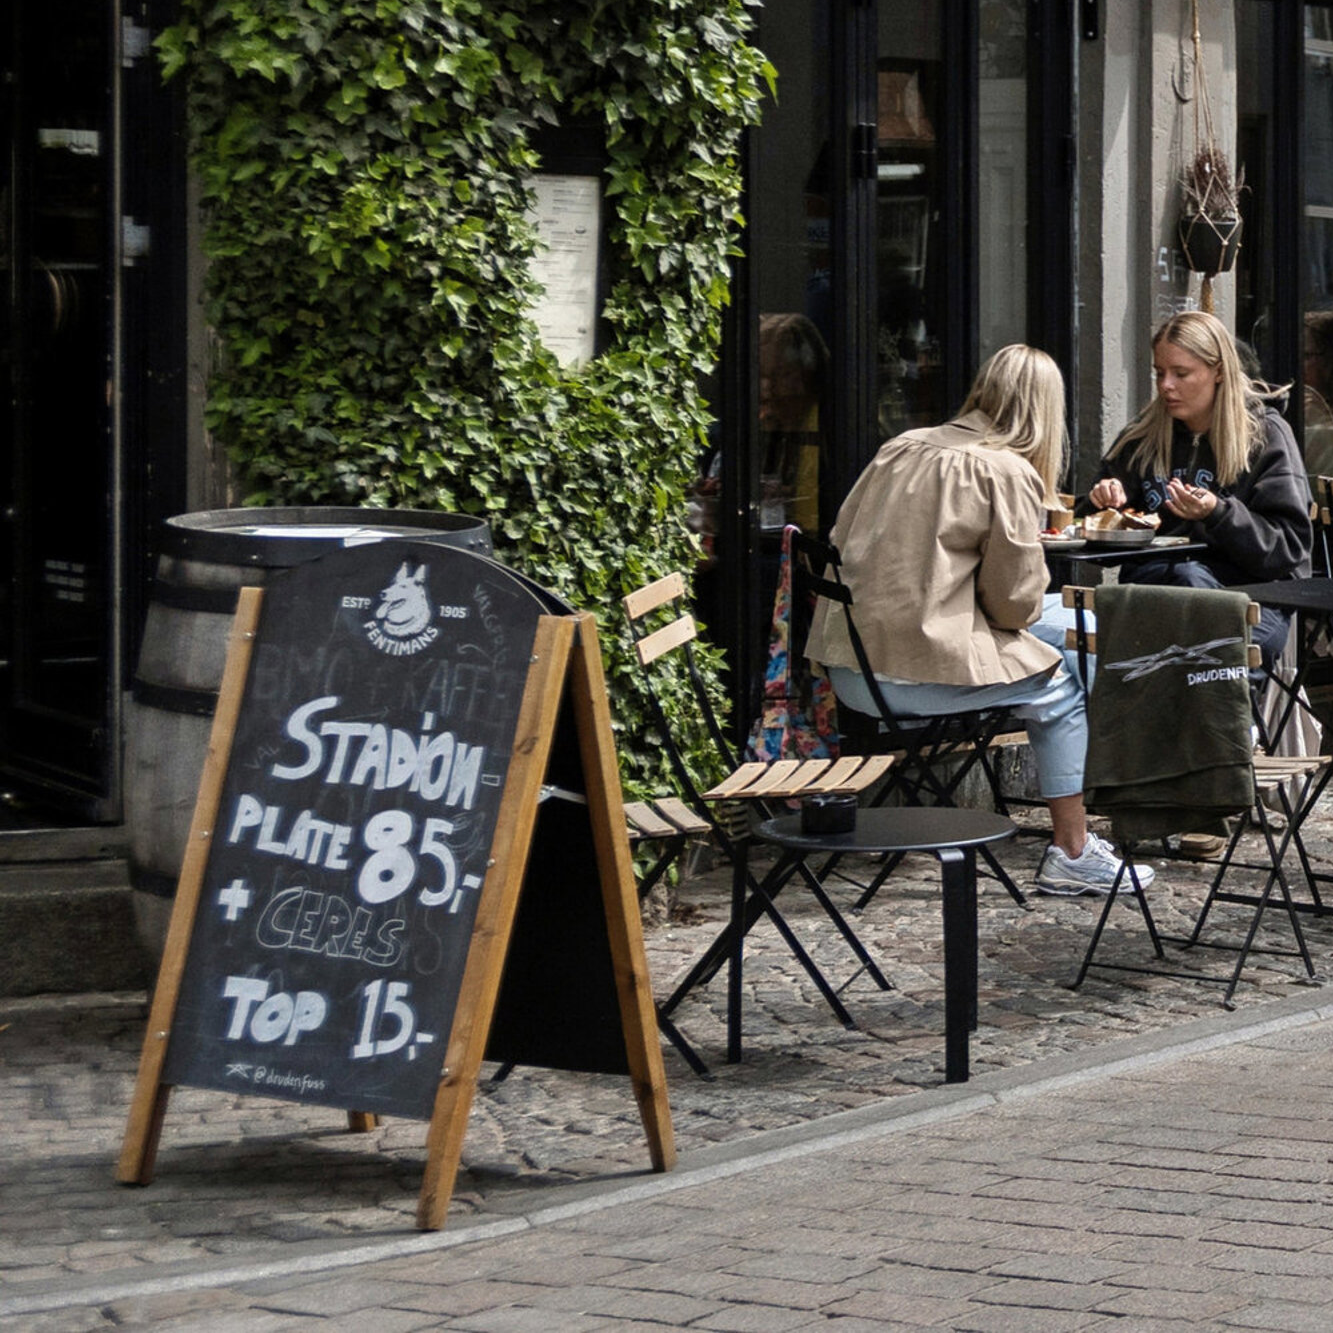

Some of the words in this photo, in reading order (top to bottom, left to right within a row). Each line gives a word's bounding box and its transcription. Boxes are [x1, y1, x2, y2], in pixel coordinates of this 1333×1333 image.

[363, 620, 439, 656] FENTIMANS
[439, 605, 467, 618] 1905
[229, 794, 352, 870] PLATE
[255, 886, 405, 966] CERES
[221, 976, 326, 1046] TOP
